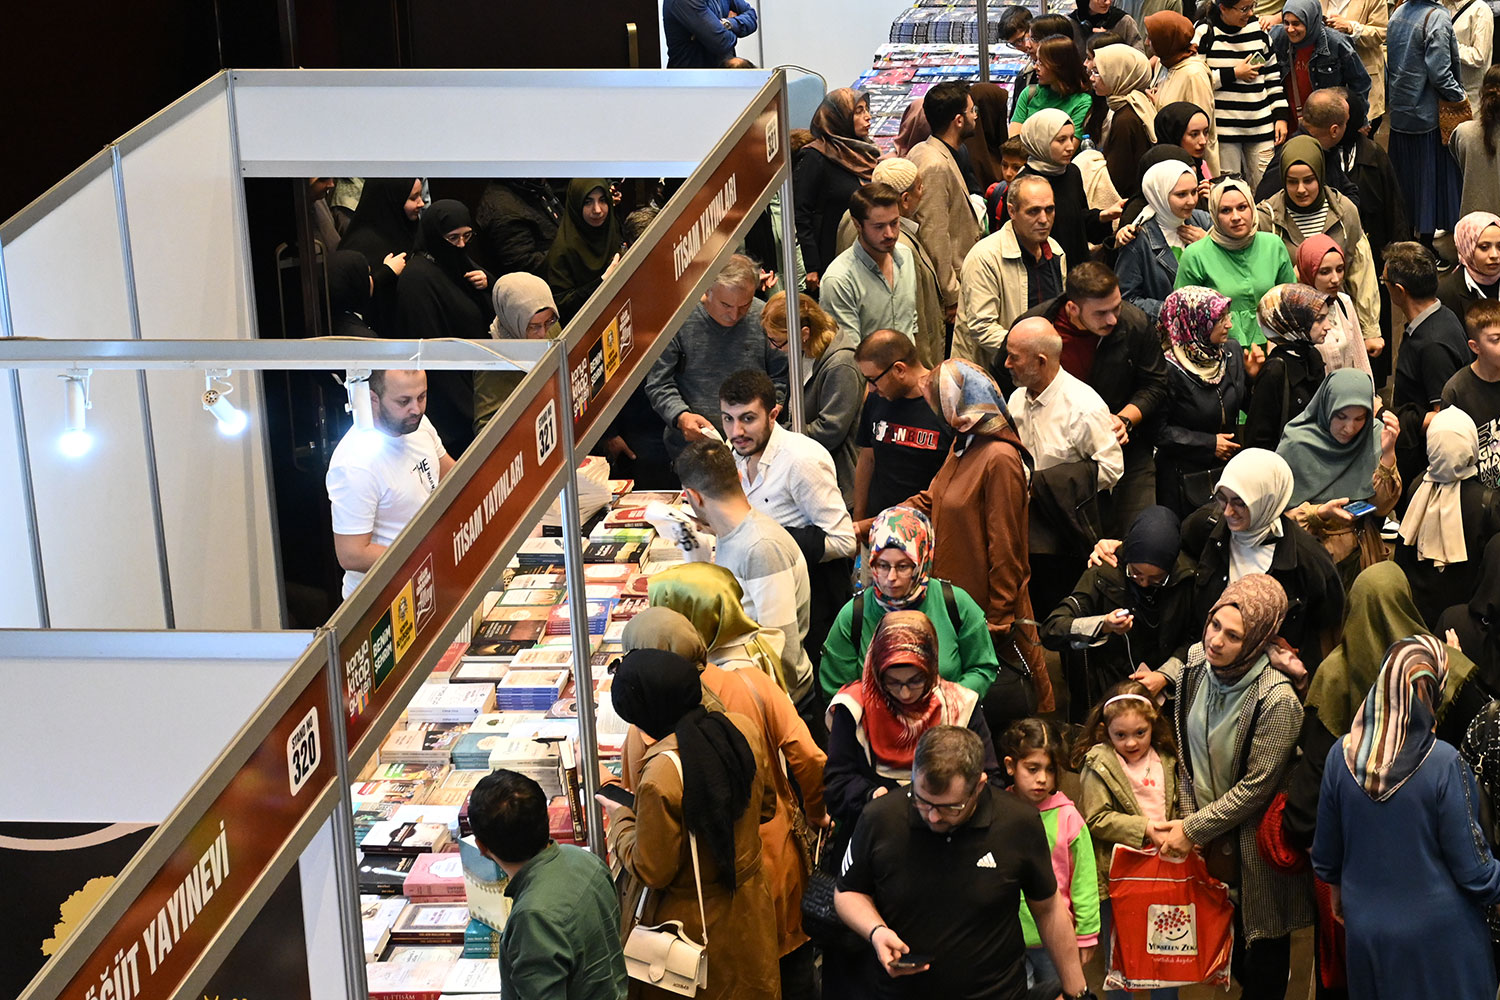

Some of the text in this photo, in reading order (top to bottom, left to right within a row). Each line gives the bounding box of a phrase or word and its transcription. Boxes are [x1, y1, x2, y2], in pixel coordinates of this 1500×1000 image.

[673, 172, 738, 282] İTİSAM YAYINLARI
[539, 420, 555, 458] 321
[453, 451, 524, 566] İTİSAM YAYINLARI
[346, 639, 369, 678] konya
[347, 657, 371, 699] kitap
[291, 715, 314, 750] STAND NO
[292, 730, 317, 786] 320
[142, 820, 231, 975] YAYINEVİ
